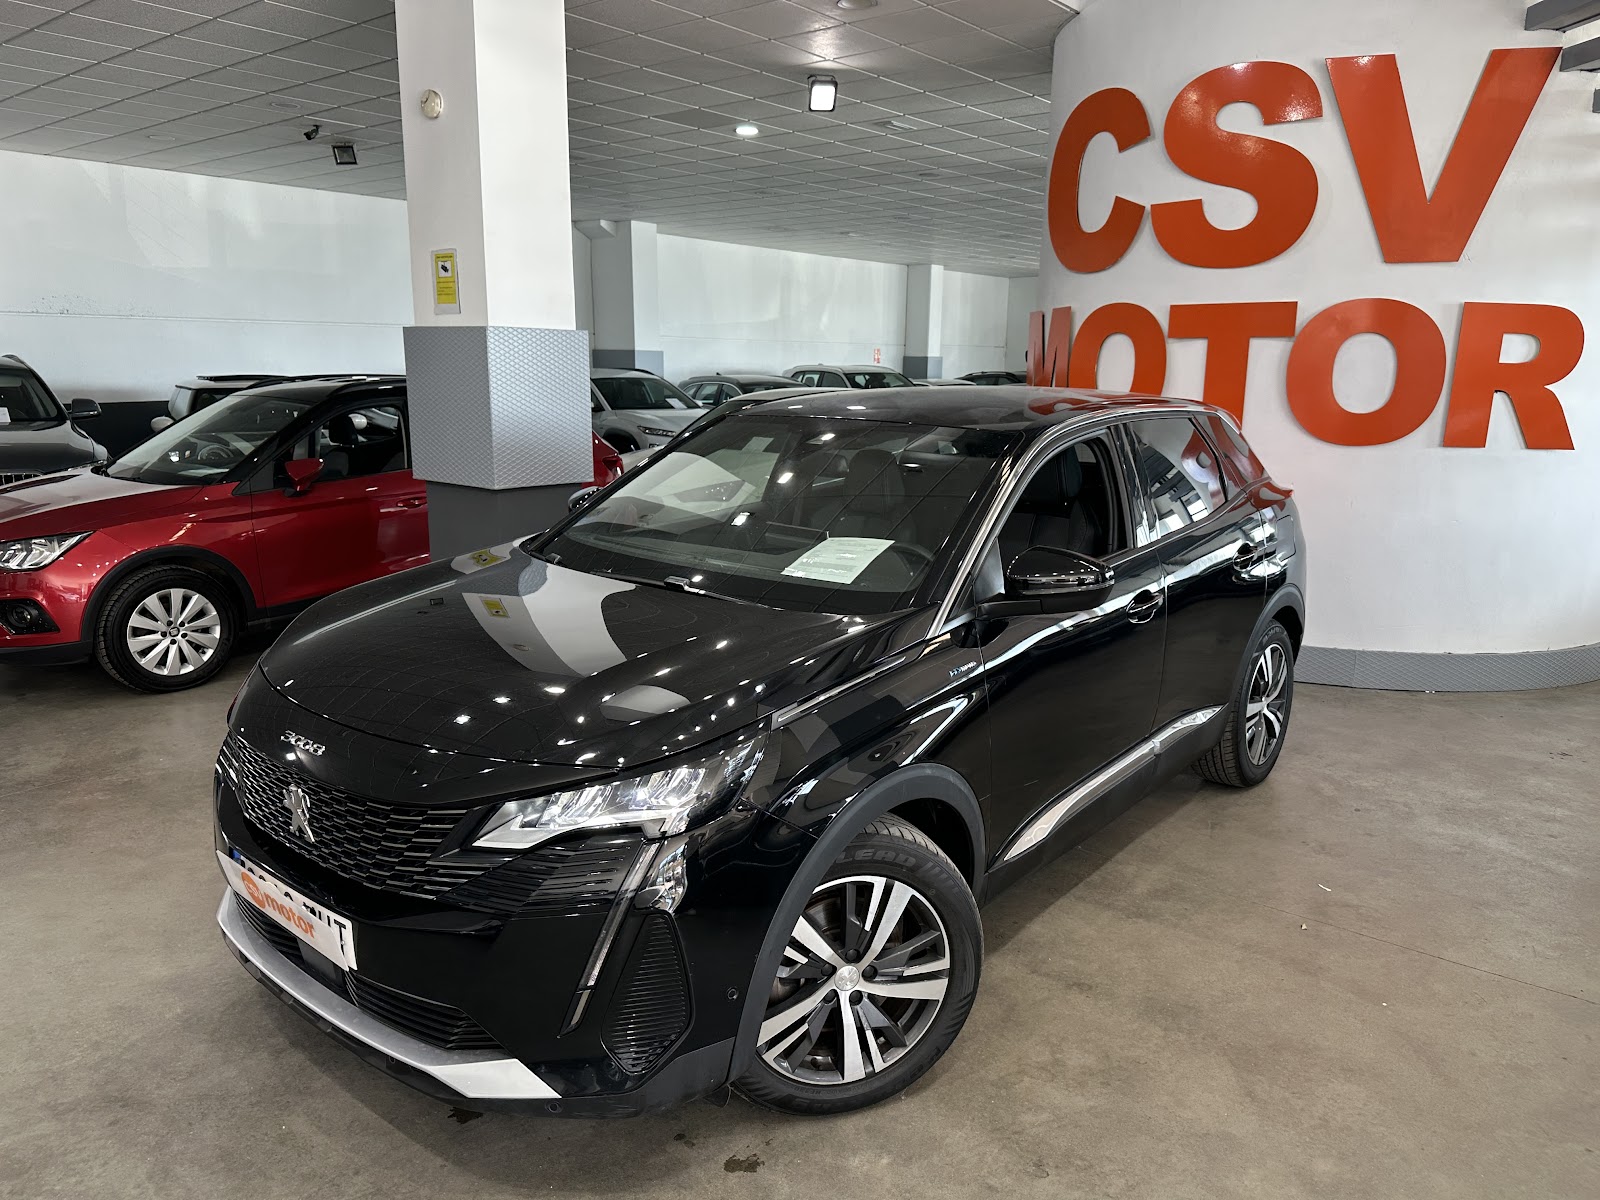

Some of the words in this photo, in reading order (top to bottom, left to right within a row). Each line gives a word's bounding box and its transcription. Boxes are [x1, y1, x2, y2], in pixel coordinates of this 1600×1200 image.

[1048, 46, 1563, 274] CSV
[1027, 297, 1585, 450] MOTOR
[281, 730, 326, 756] 3008
[263, 891, 315, 939] motor
